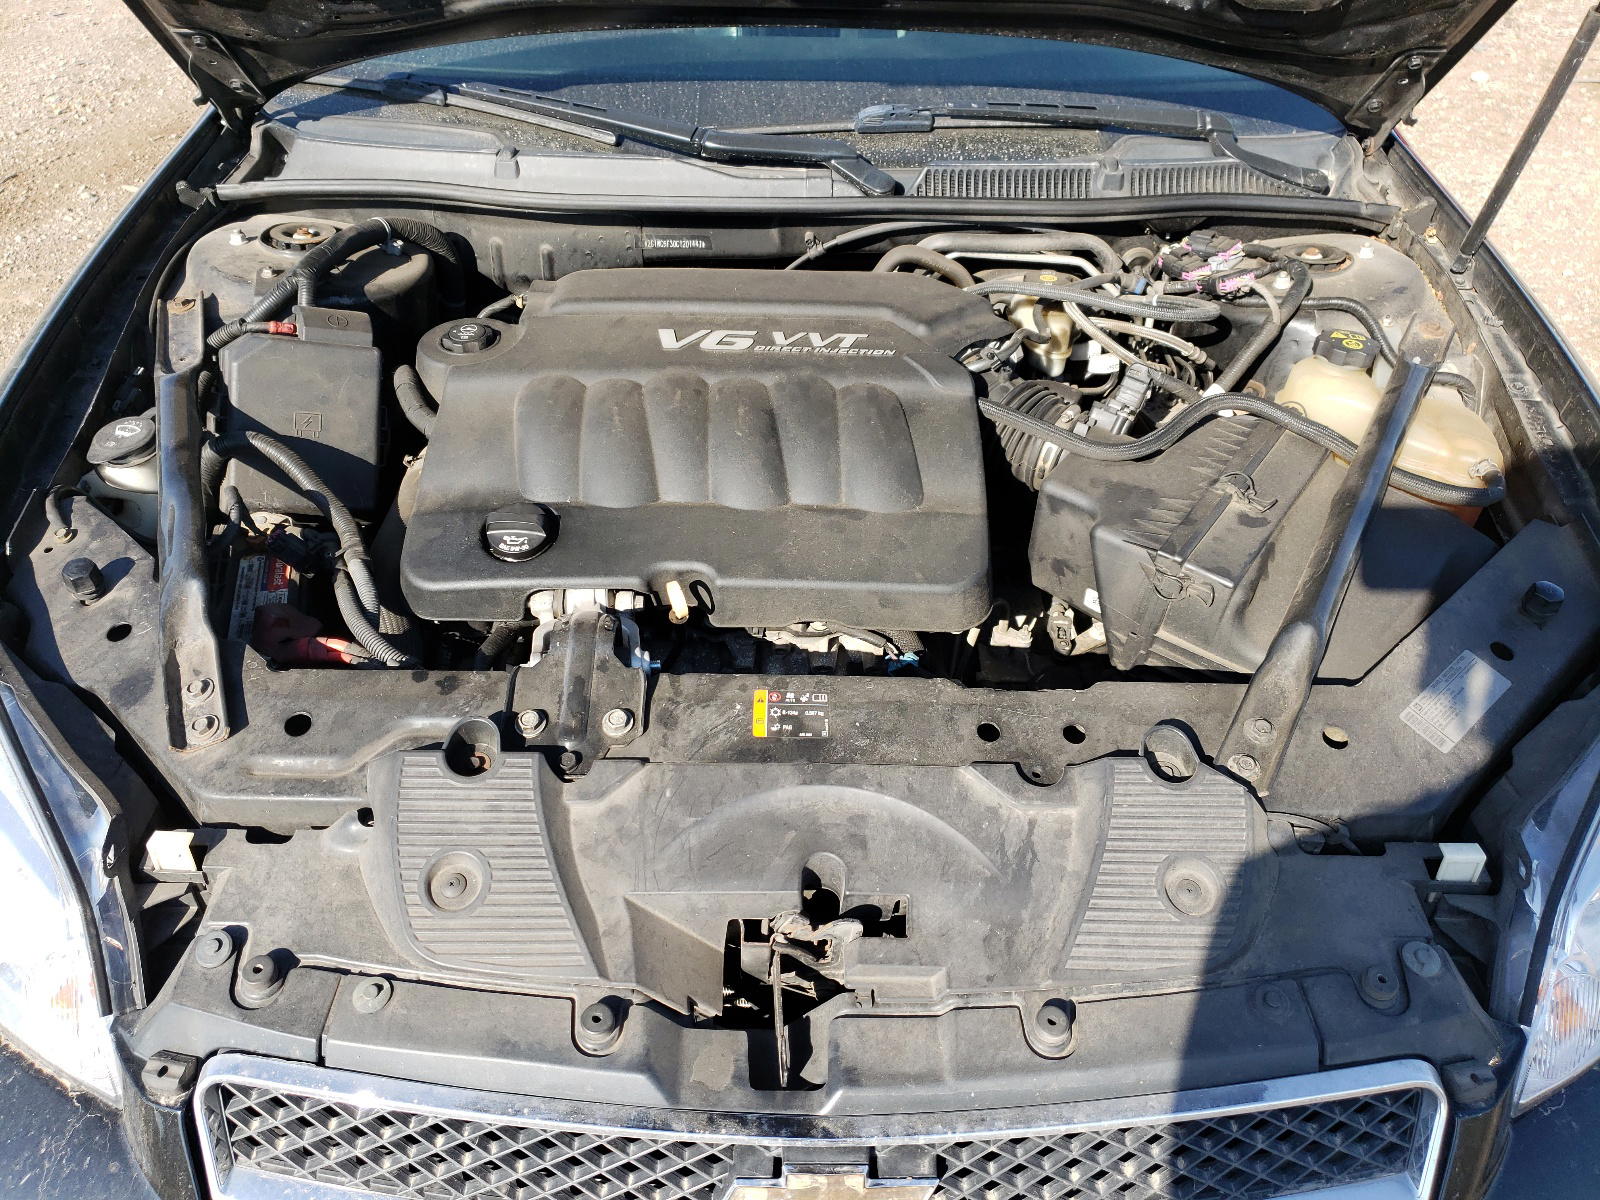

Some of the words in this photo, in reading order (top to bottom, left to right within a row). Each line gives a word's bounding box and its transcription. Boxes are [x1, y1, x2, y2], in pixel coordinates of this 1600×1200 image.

[658, 328, 758, 350] V6
[772, 331, 869, 347] VVT
[814, 346, 896, 355] INJECTION
[273, 558, 286, 585] uralast
